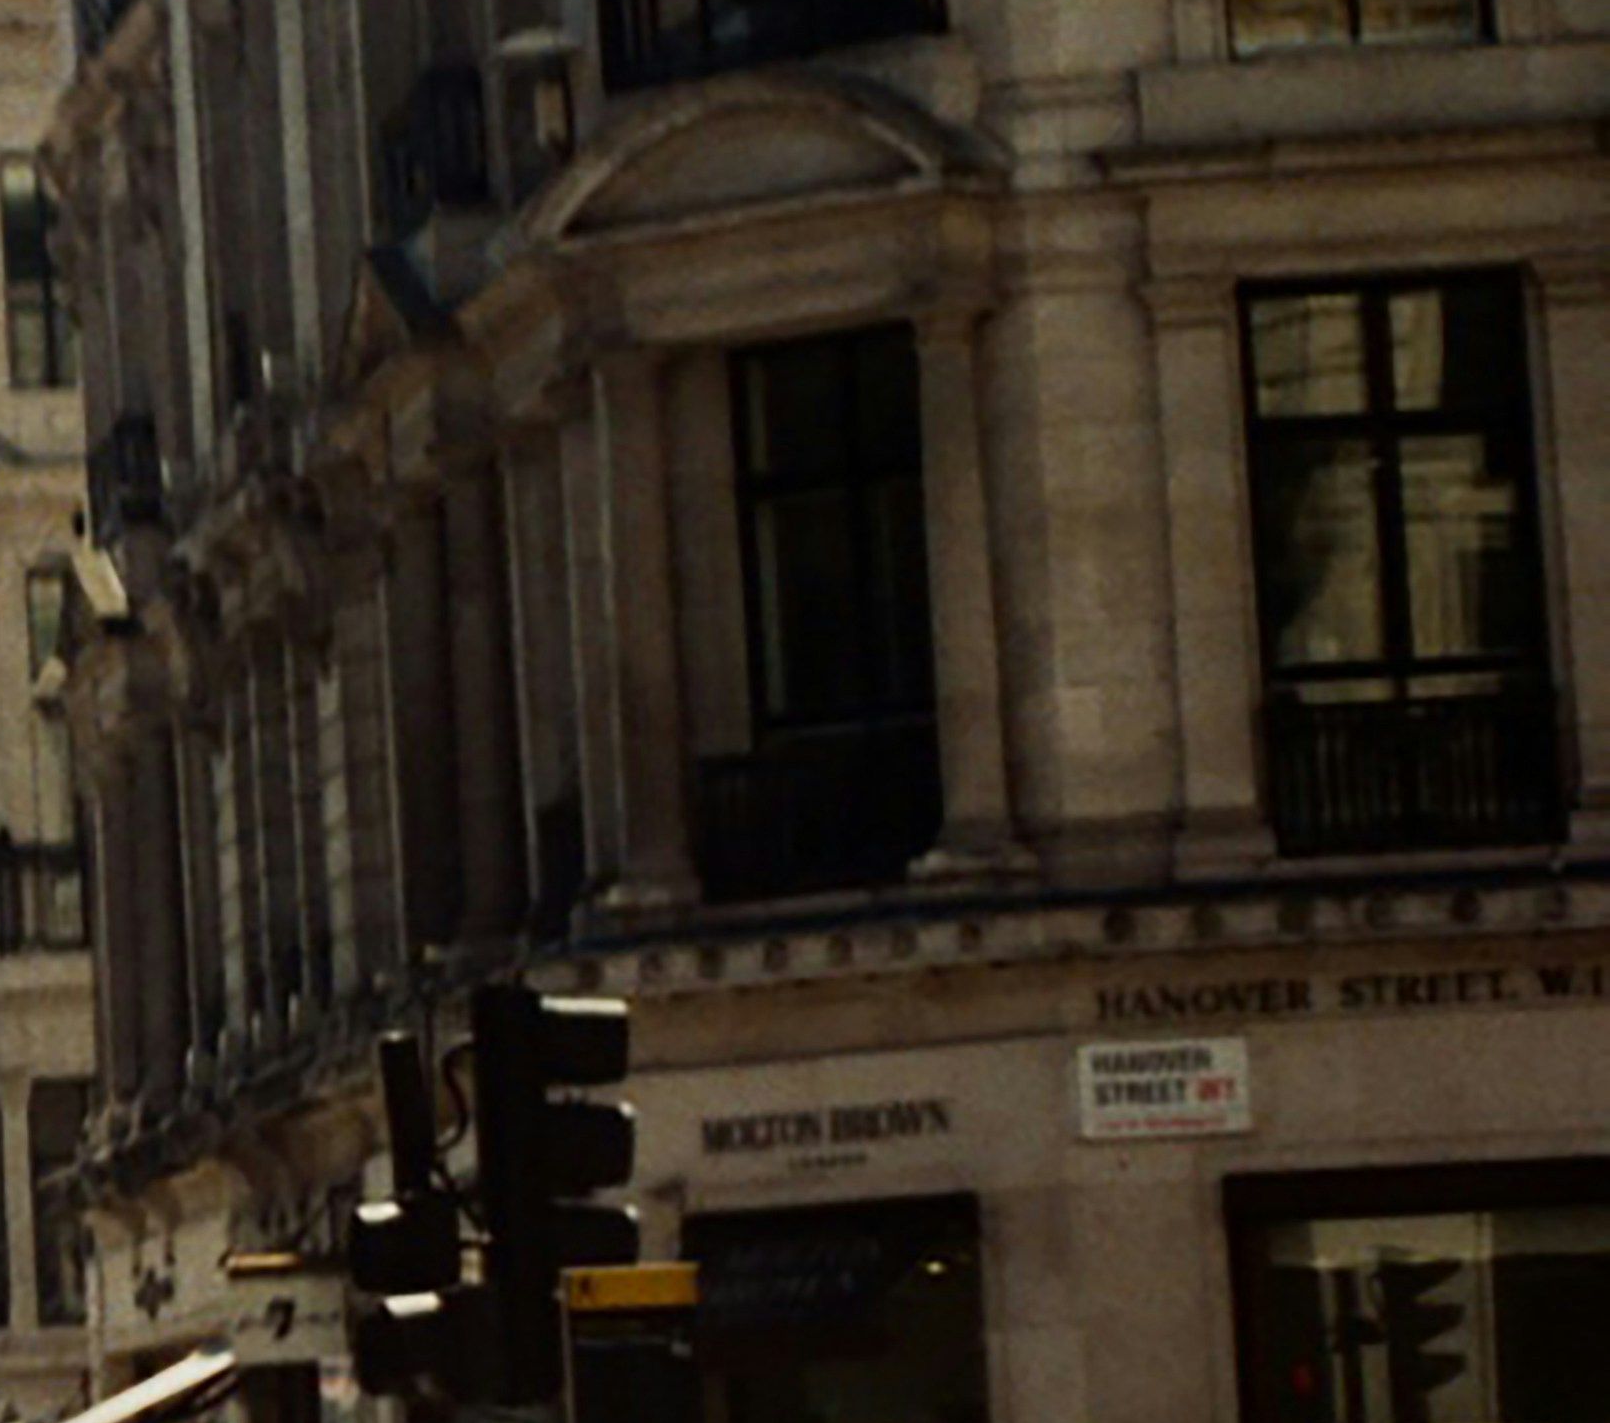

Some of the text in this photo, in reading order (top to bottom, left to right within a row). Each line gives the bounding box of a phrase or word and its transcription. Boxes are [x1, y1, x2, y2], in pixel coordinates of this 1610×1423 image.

[1096, 979, 1312, 1019] HANOVER
[1092, 1048, 1212, 1074] HANOVER
[1095, 1078, 1237, 1105] STREET W1
